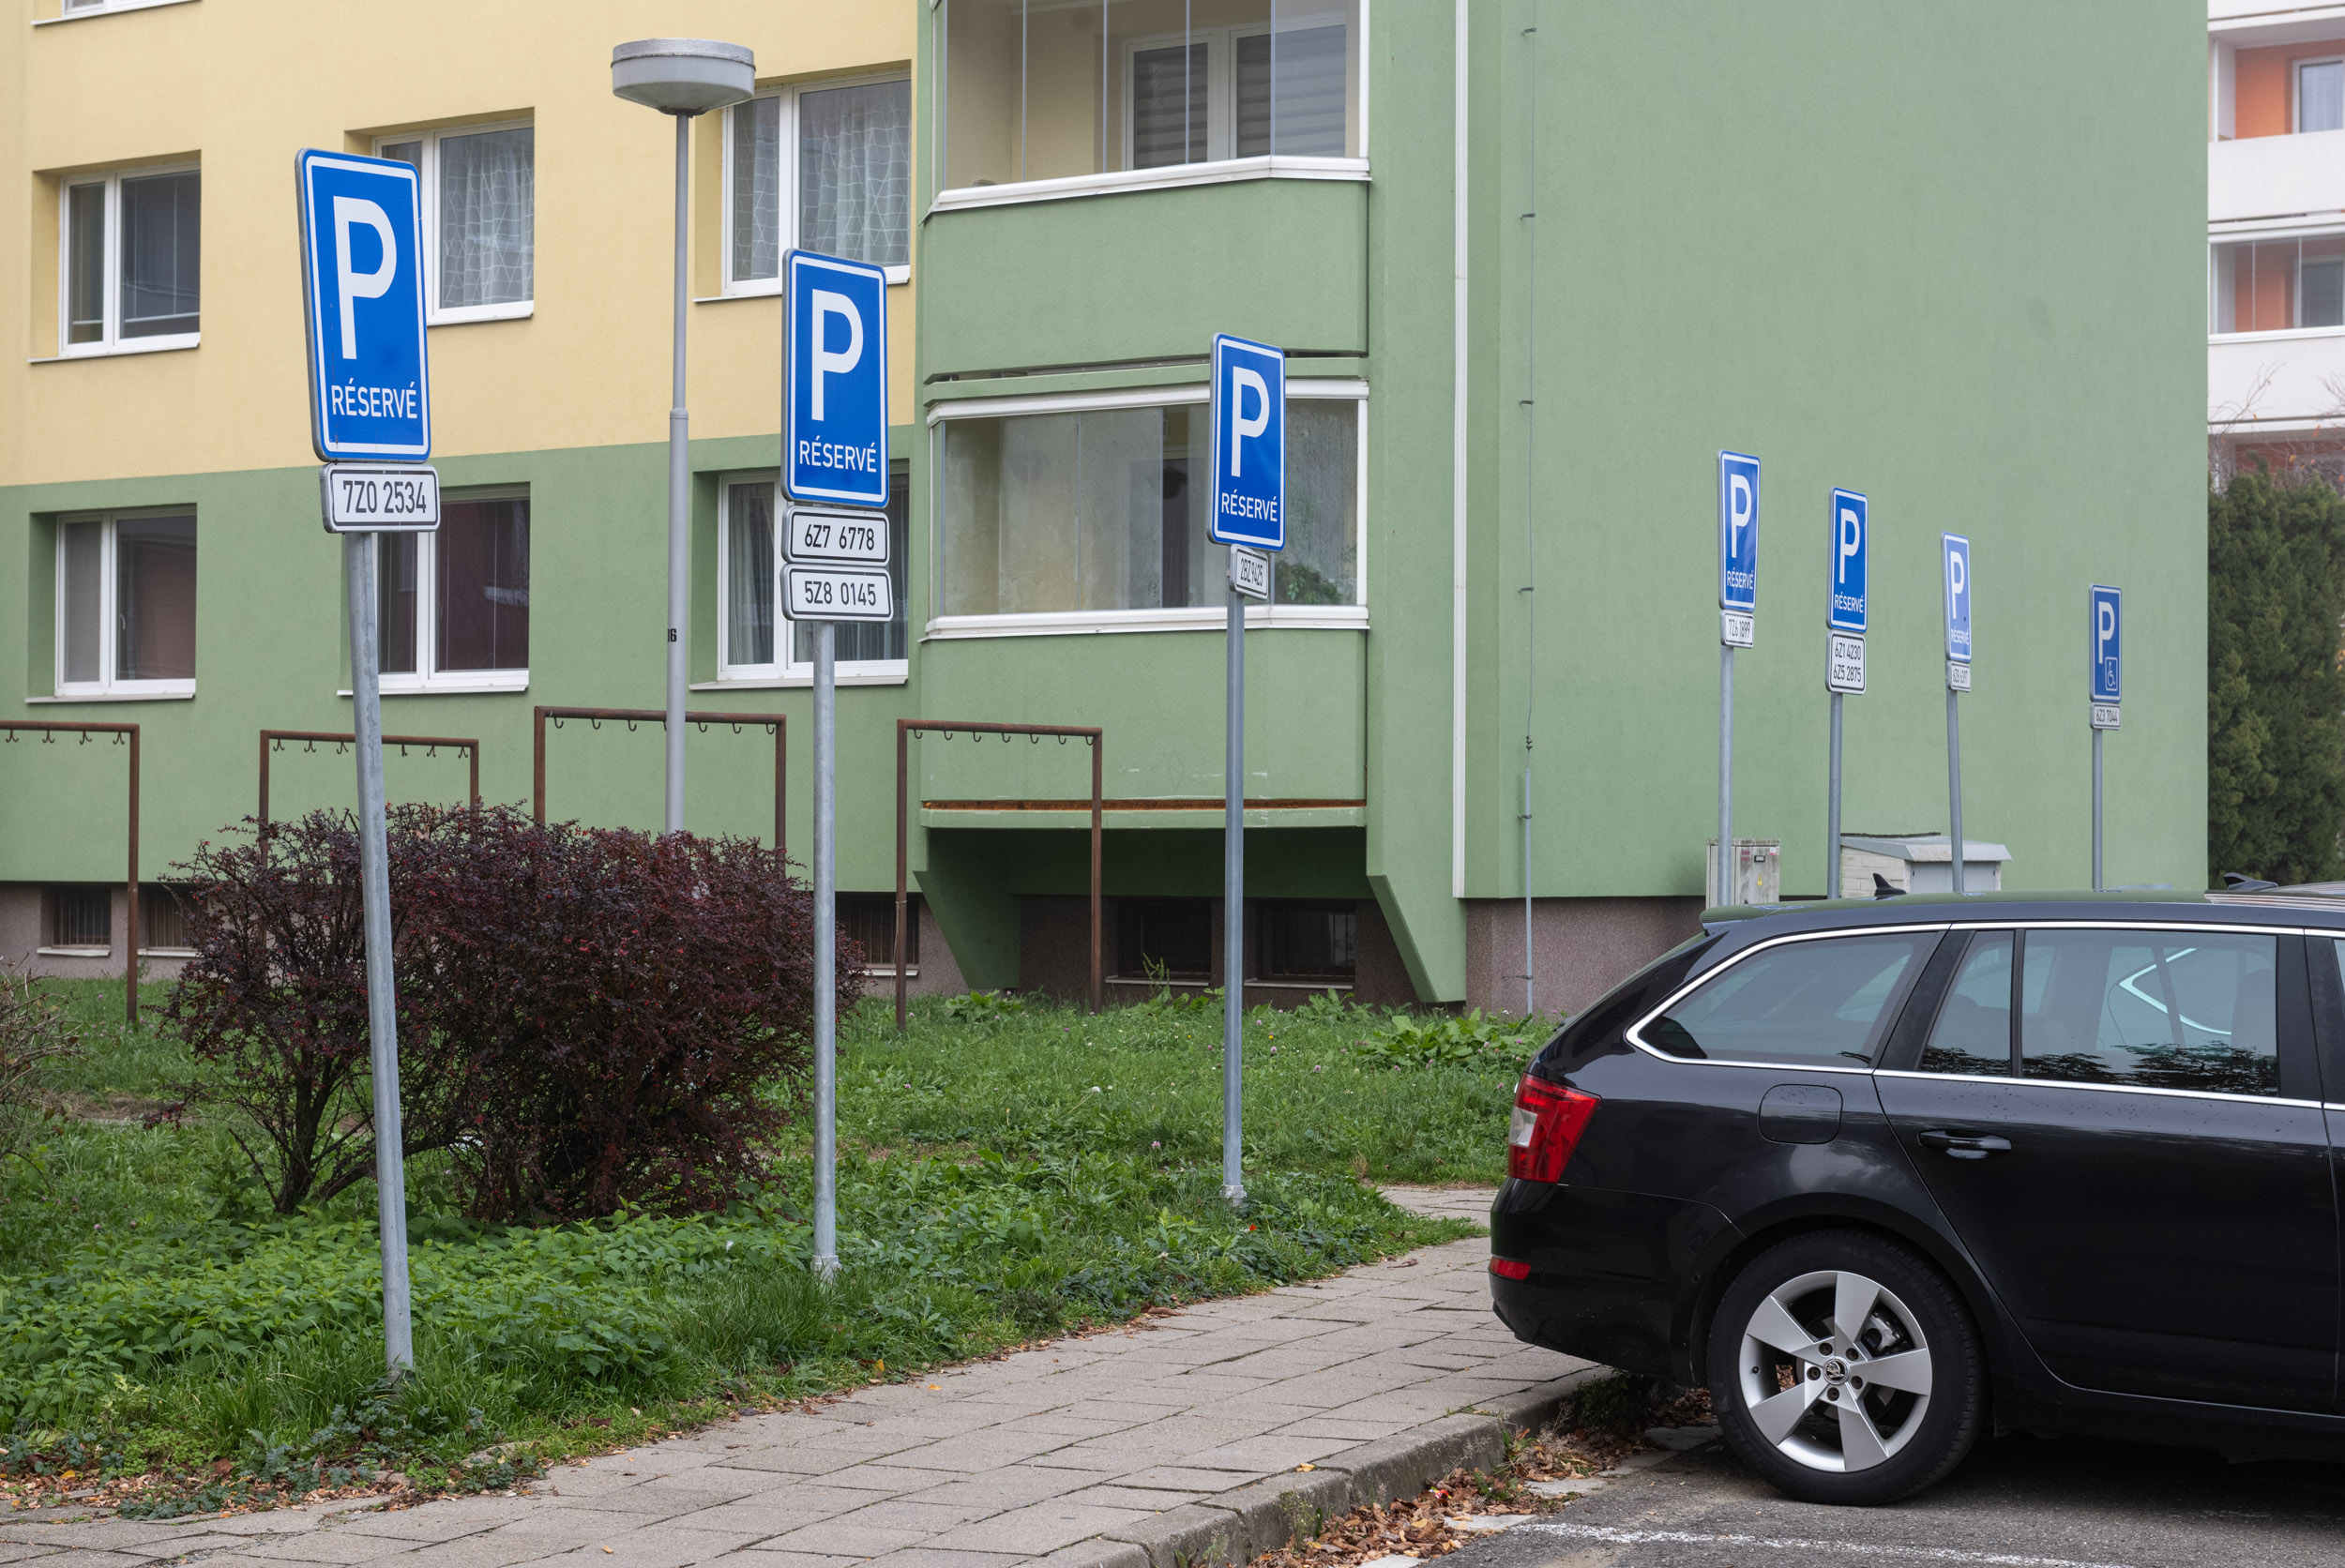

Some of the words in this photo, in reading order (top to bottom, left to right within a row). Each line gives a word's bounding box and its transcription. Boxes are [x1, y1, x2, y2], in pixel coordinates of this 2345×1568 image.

[333, 195, 397, 360] P
[811, 289, 864, 421] P
[331, 378, 418, 419] RÉSERVÉ
[1231, 366, 1270, 477] P
[799, 435, 877, 473] RÉSERVÉ
[342, 480, 378, 513] 7Z0
[384, 481, 427, 514] 2534
[1221, 489, 1278, 522] RÉSERVÉ
[1731, 474, 1752, 558] P
[804, 523, 831, 549] 6Z7
[839, 526, 874, 551] 6778
[1838, 508, 1861, 584] P
[804, 580, 833, 605] 5Z8
[840, 581, 876, 607] 0145
[1727, 566, 1754, 590] RÉSERVÉ
[1949, 550, 1965, 620] P
[1835, 591, 1864, 613] RÉSERVÉ
[1835, 641, 1845, 658] 6Z1
[1847, 643, 1861, 660] 4230
[2097, 601, 2115, 665] P
[1834, 664, 1845, 680] 6Z5
[1847, 666, 1861, 683] 2875
